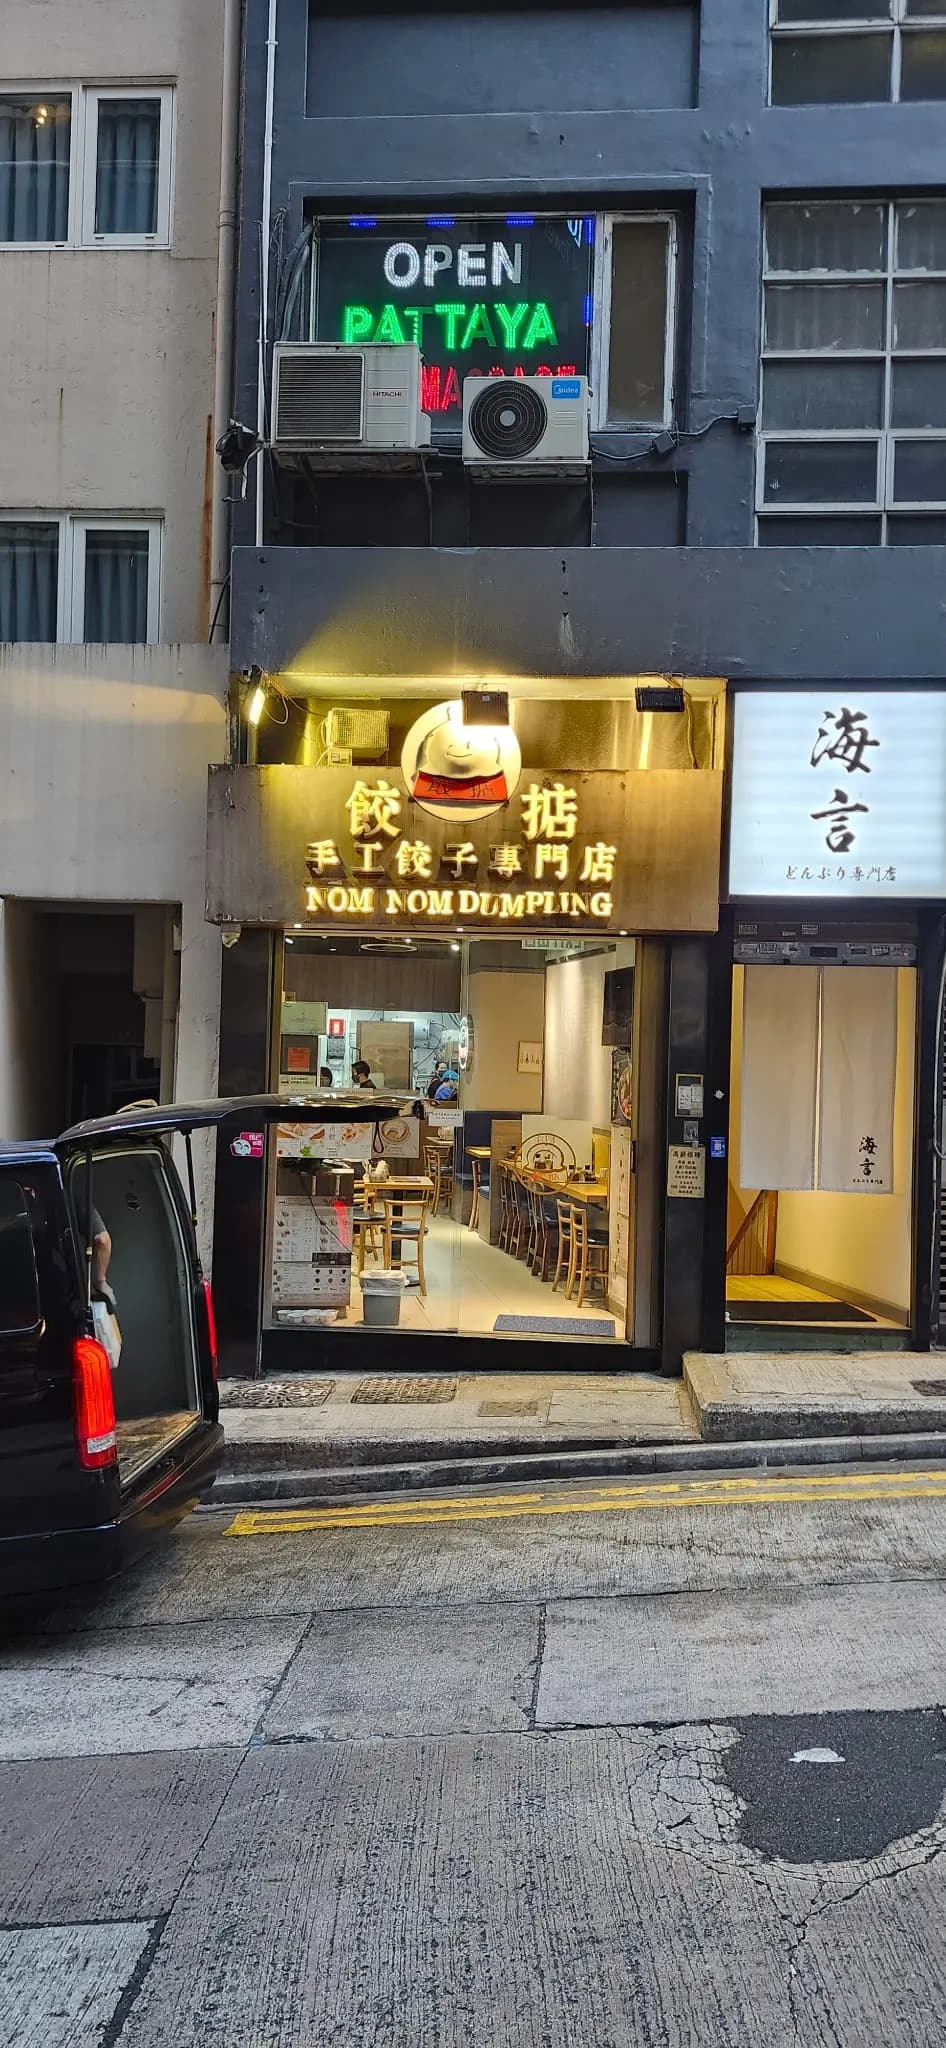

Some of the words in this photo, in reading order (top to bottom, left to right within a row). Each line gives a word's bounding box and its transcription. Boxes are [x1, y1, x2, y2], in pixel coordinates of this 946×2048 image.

[382, 241, 523, 288] OPEN
[343, 303, 560, 351] PATTAYA
[553, 384, 579, 395] Midea
[810, 707, 880, 852] 海言
[345, 780, 402, 838] 餃
[520, 784, 578, 840] 掂
[303, 840, 617, 882] 手工餃子專門店
[305, 886, 374, 913] NOM
[385, 888, 453, 914] NOM
[458, 889, 613, 917] DUMPLING
[859, 1136, 878, 1176] 海言
